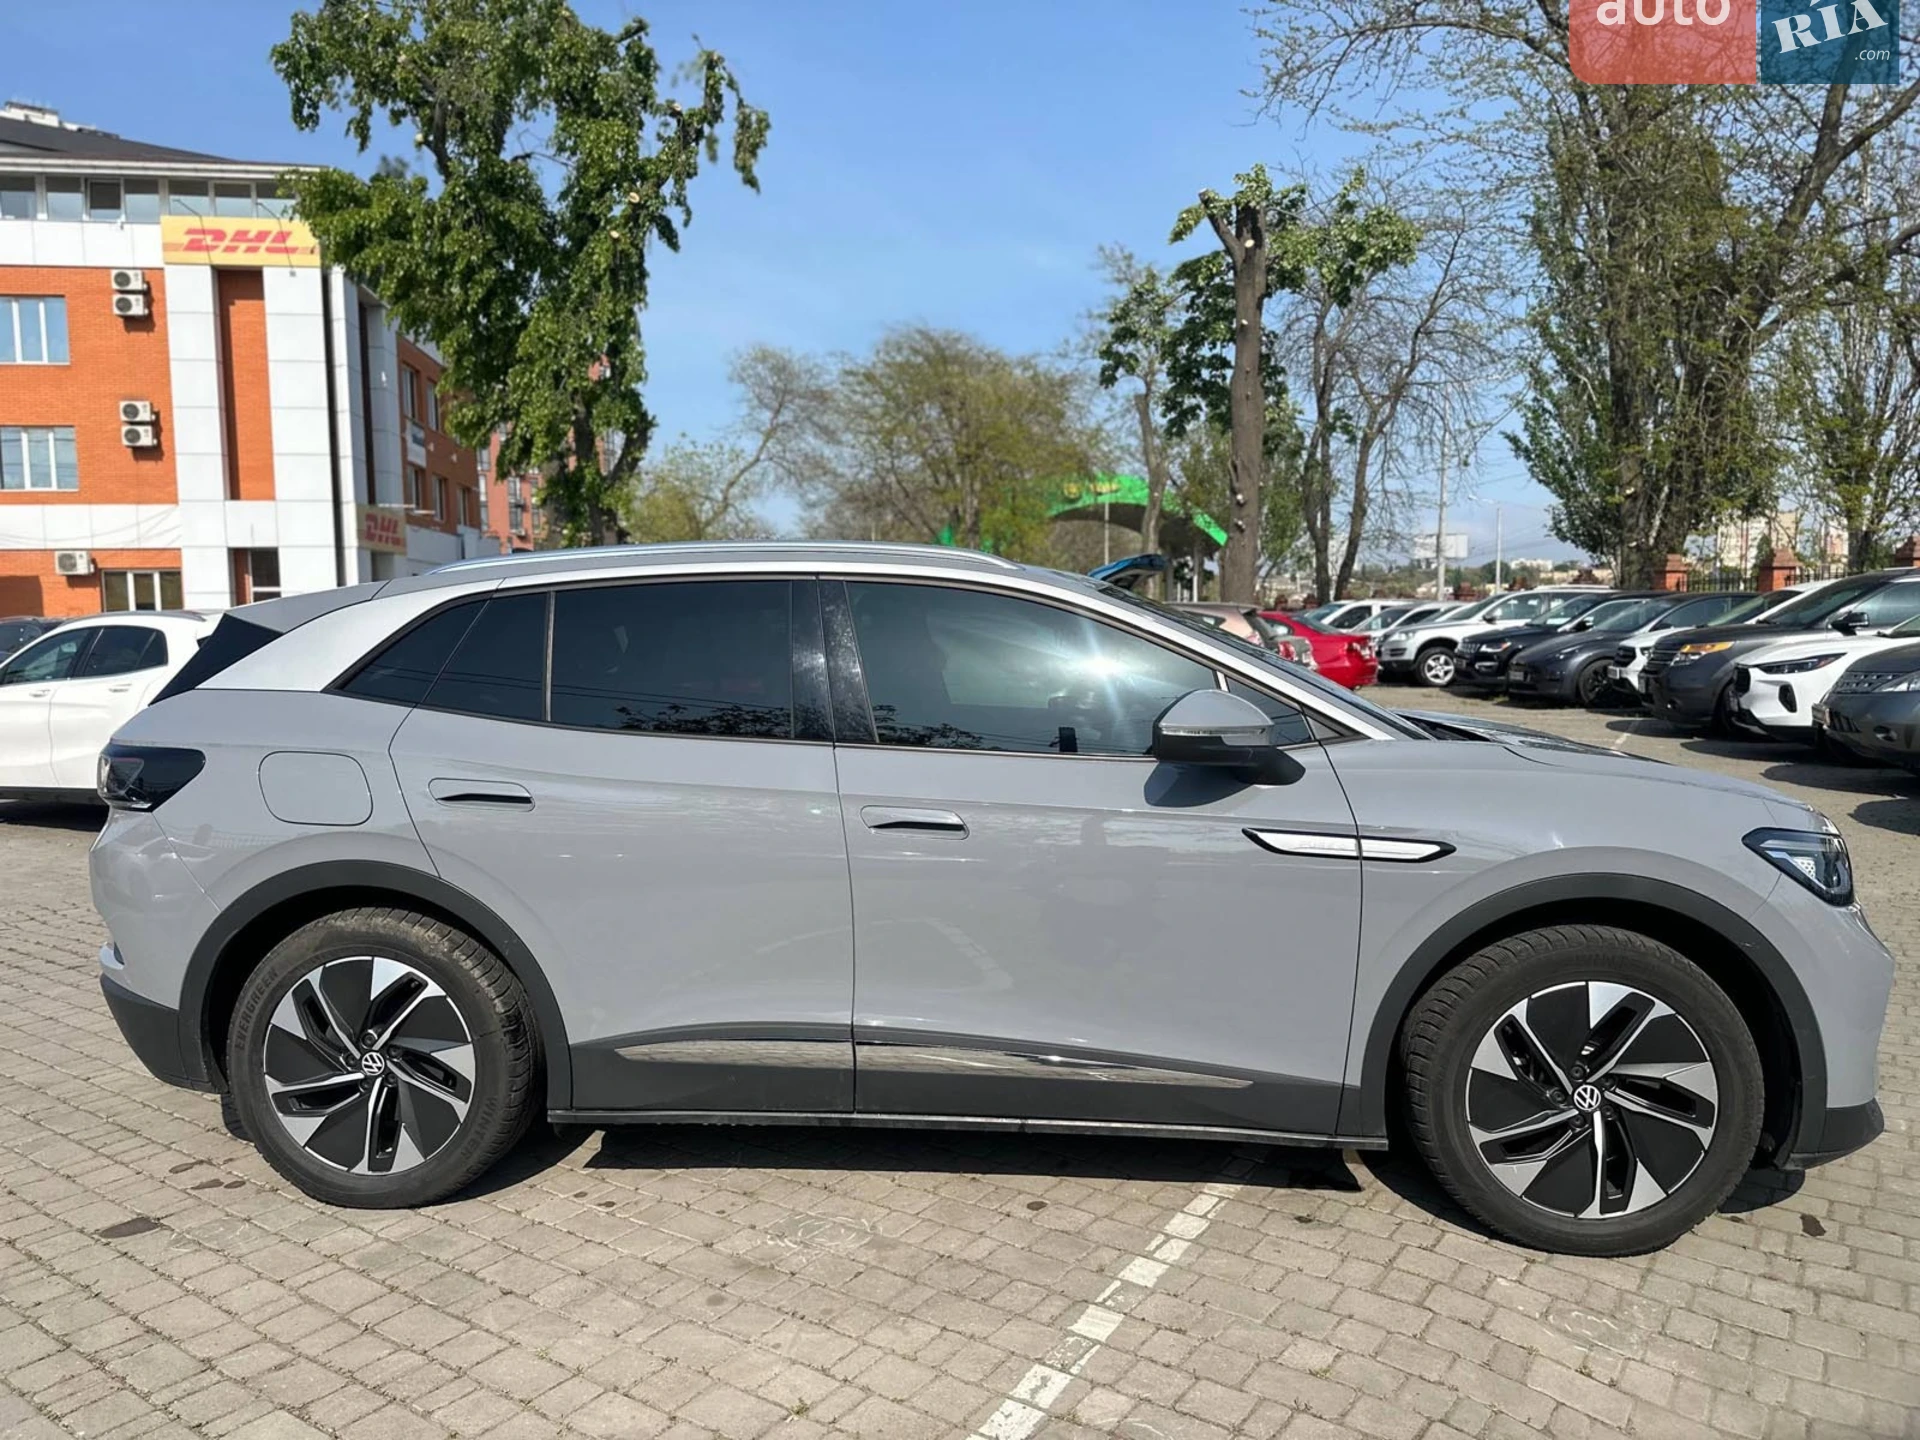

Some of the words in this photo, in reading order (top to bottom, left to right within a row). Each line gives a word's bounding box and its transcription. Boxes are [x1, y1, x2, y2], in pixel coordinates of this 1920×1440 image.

[183, 228, 299, 254] DHL
[365, 512, 405, 547] DHL
[235, 967, 279, 1051] EVERGREEN
[1574, 1084, 1601, 1111] VW
